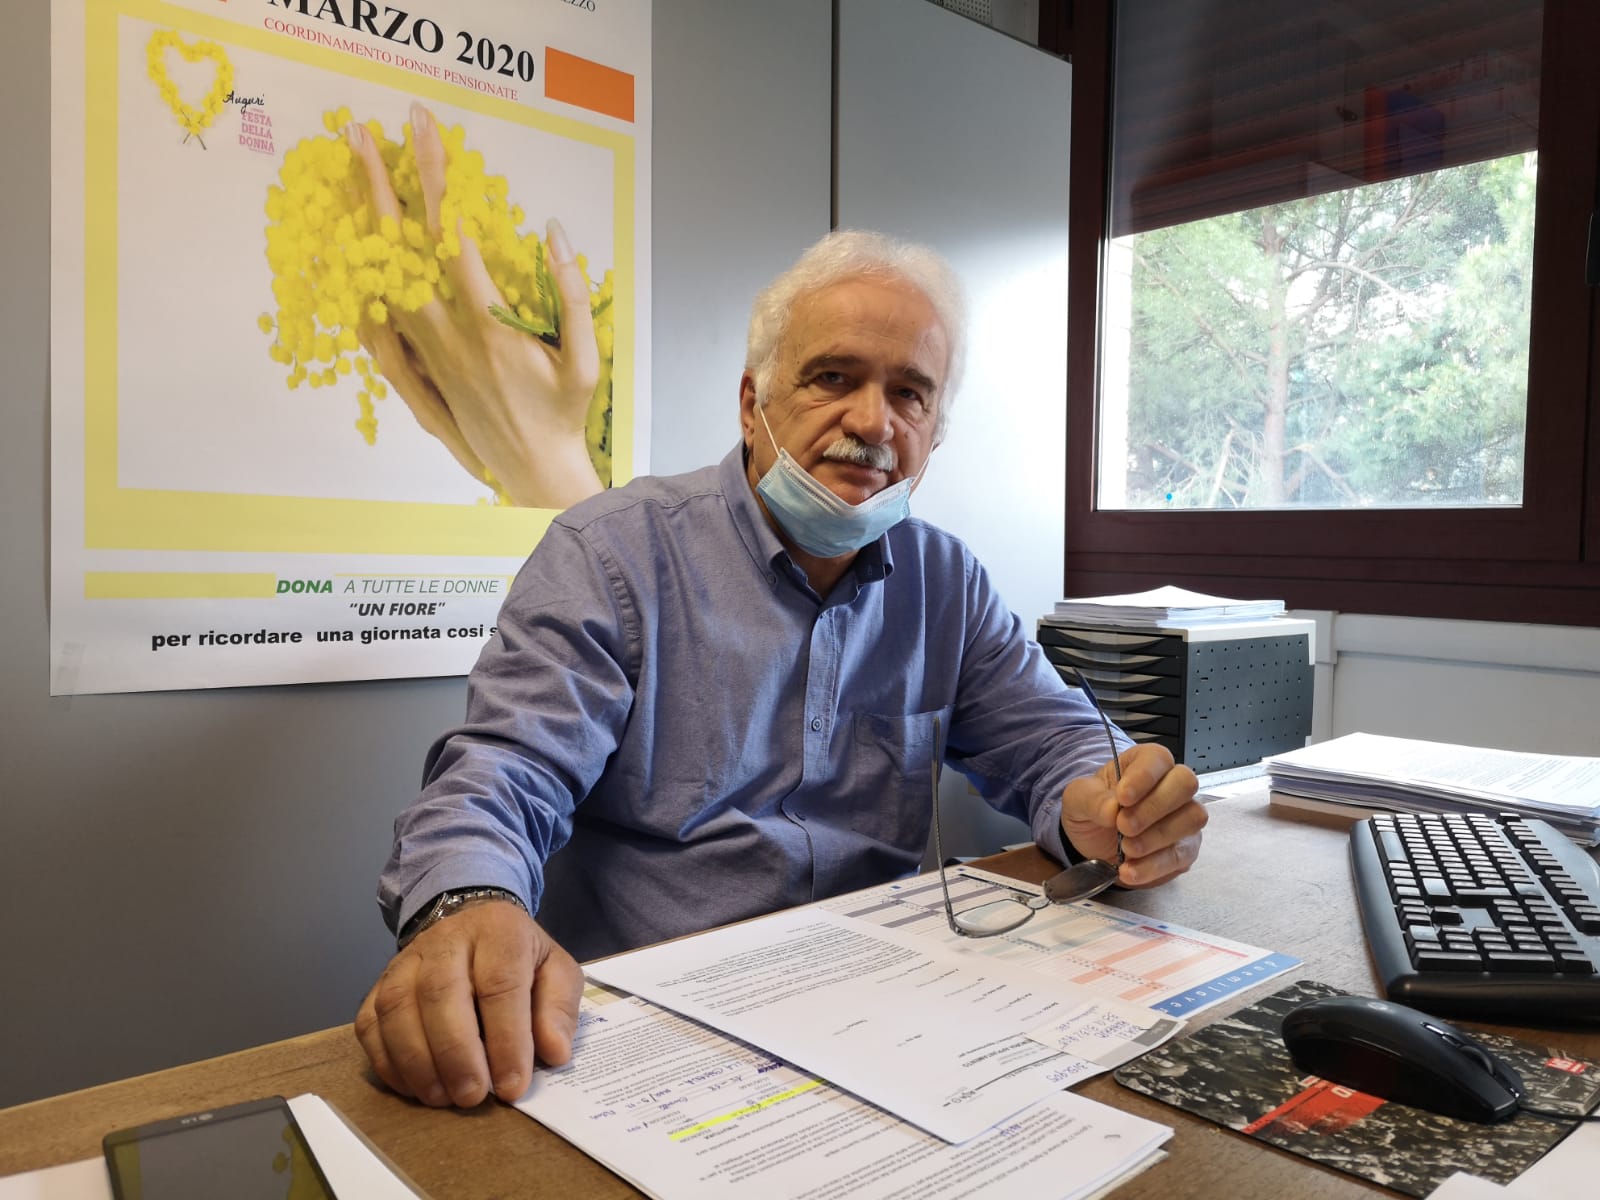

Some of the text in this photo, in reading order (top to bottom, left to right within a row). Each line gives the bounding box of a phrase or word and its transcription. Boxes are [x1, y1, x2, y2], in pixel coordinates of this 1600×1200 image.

[264, 17, 518, 101] COORDINAMENTO DONNE PENSIONATE
[456, 31, 535, 82] 2020
[222, 90, 265, 114] Auguri
[241, 111, 272, 127] FESTA
[241, 122, 273, 139] DELLA
[239, 134, 275, 152] DONNA
[276, 580, 499, 594] DONA A TUTTE LE DONNE
[152, 634, 191, 651] per
[199, 629, 303, 646] ricordare
[317, 630, 354, 642] una
[361, 626, 441, 644] giornata
[447, 624, 484, 638] cosi
